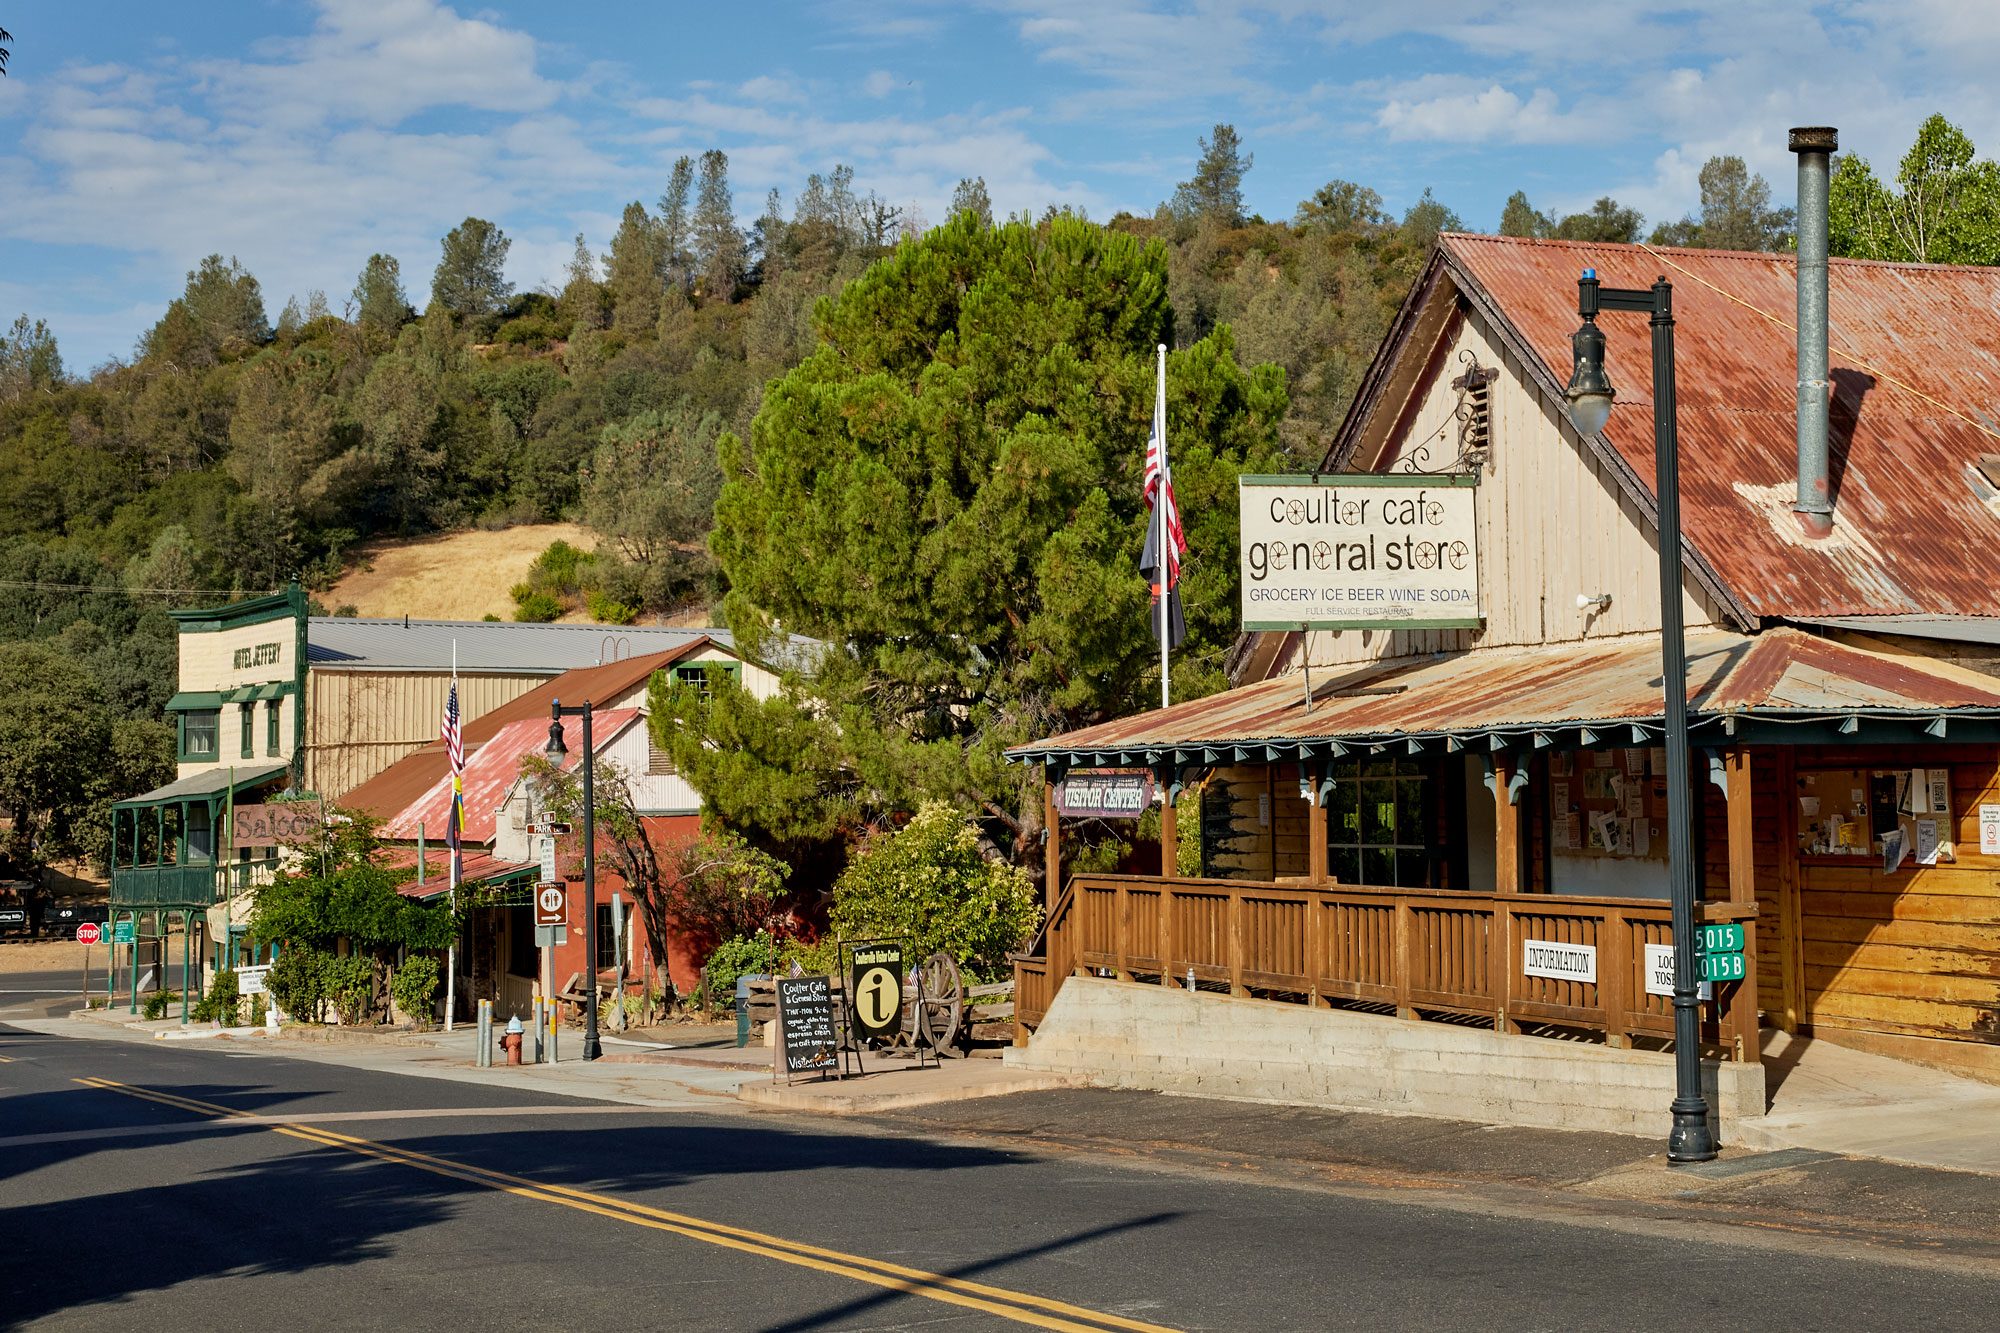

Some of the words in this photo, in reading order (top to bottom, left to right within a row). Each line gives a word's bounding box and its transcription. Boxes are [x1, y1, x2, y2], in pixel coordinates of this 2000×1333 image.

[1270, 489, 1370, 526] coulter
[1383, 490, 1445, 526] cafe
[1249, 534, 1375, 581] general
[1386, 534, 1469, 571] store
[1250, 588, 1318, 601] GROCERY
[1321, 588, 1344, 601] ICE
[1348, 588, 1385, 601] BEER
[1389, 588, 1426, 602] WINE
[1430, 589, 1471, 602] SODA
[1305, 607, 1326, 616] FULL
[1326, 607, 1361, 616] SERVICE
[1362, 607, 1415, 617] RESTAURANT
[253, 641, 282, 667] JEFFERY
[1064, 787, 1102, 808] VISITOR
[1103, 787, 1143, 809] CENTER
[235, 809, 320, 839] Saloon
[534, 824, 552, 834] PARK
[60, 910, 73, 918] 49
[78, 929, 99, 942] STOP
[1695, 927, 1734, 950] 5015
[1528, 947, 1590, 974] INFORMATION
[1657, 955, 1675, 969] LOC
[1695, 956, 1742, 978] 015B
[783, 982, 809, 995] Coulter
[810, 981, 827, 994] Cafe
[792, 993, 813, 1004] General
[813, 992, 828, 1002] Store
[818, 1022, 828, 1030] ice
[787, 1031, 813, 1040] espresso
